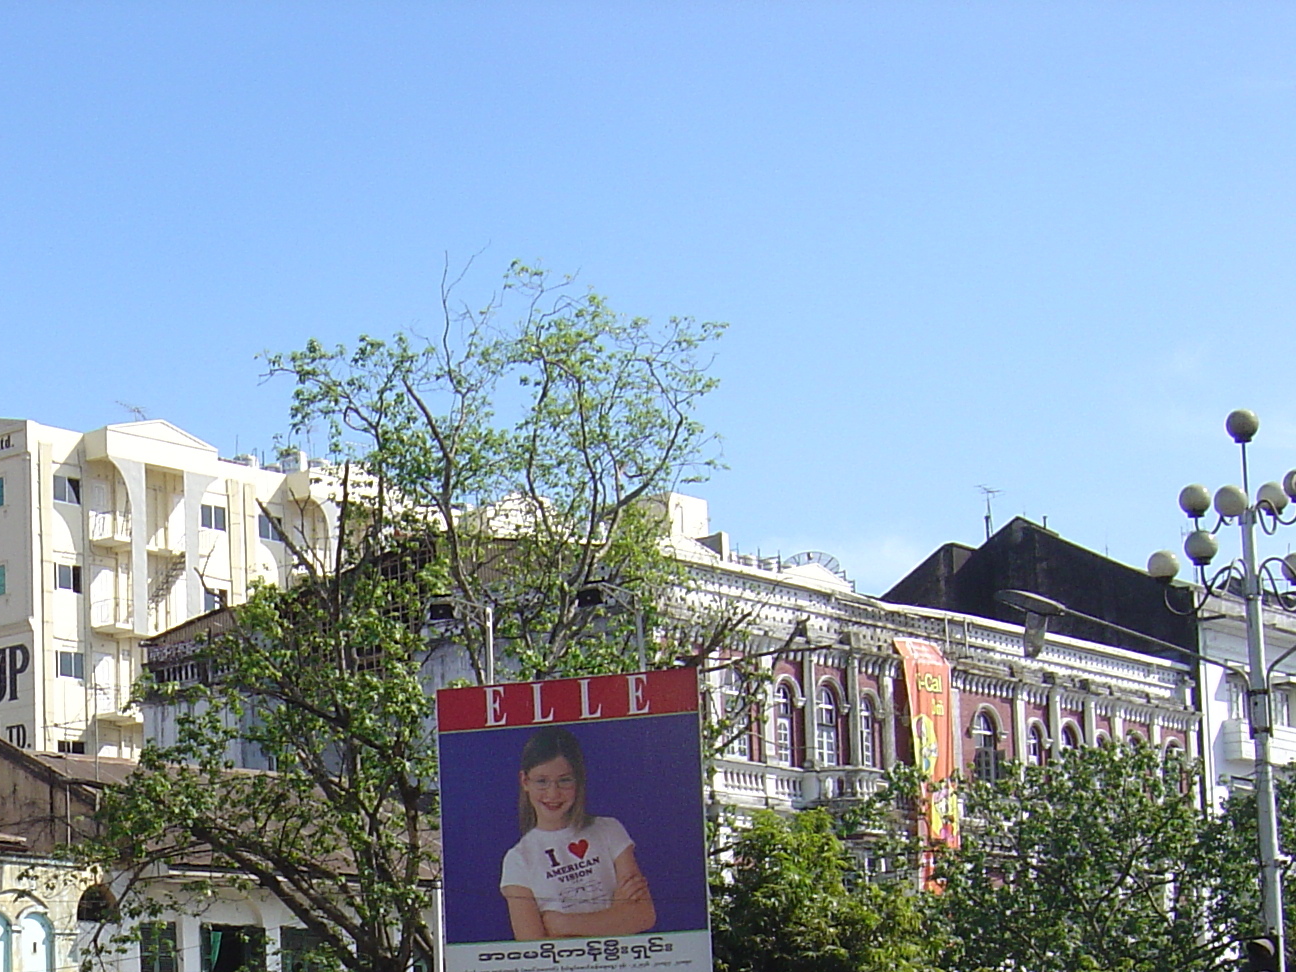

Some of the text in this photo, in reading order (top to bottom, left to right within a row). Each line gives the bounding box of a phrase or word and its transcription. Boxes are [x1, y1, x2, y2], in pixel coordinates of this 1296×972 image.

[484, 673, 651, 727] ELLE
[545, 847, 561, 867] I
[546, 856, 600, 879] AMERICAN
[558, 867, 593, 883] VISION
